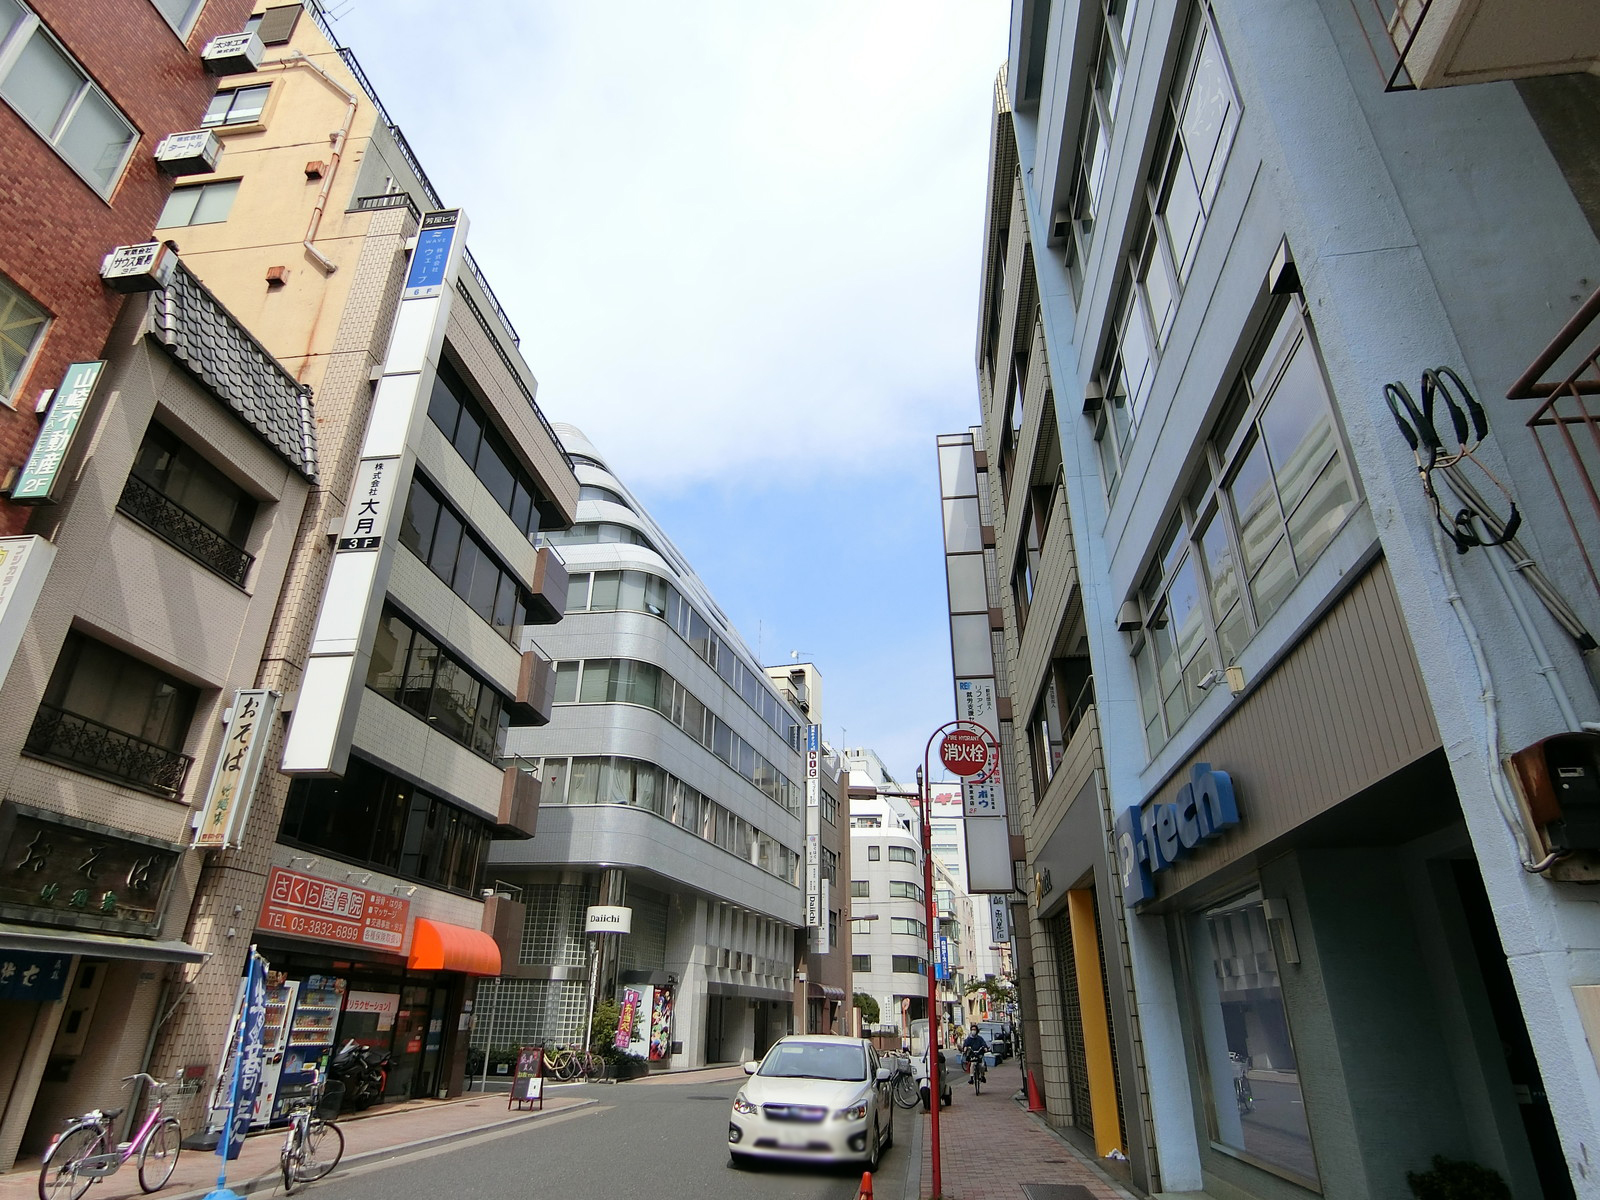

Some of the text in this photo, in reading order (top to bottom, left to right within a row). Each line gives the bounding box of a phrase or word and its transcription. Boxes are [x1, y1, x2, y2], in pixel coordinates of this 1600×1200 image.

[168, 142, 203, 151] タートル
[34, 368, 98, 475] 山崎不動産
[22, 478, 49, 492] 2F
[369, 463, 384, 496] 株式会社
[353, 498, 380, 535] 大月
[348, 538, 373, 549] 3F
[222, 697, 259, 772] おそば
[944, 743, 985, 762] 消火栓
[275, 876, 363, 915] さくら整骨院
[373, 906, 398, 919] マッサージ
[590, 914, 620, 923] Daiichi
[268, 912, 358, 940] TEL 03-3832-6899
